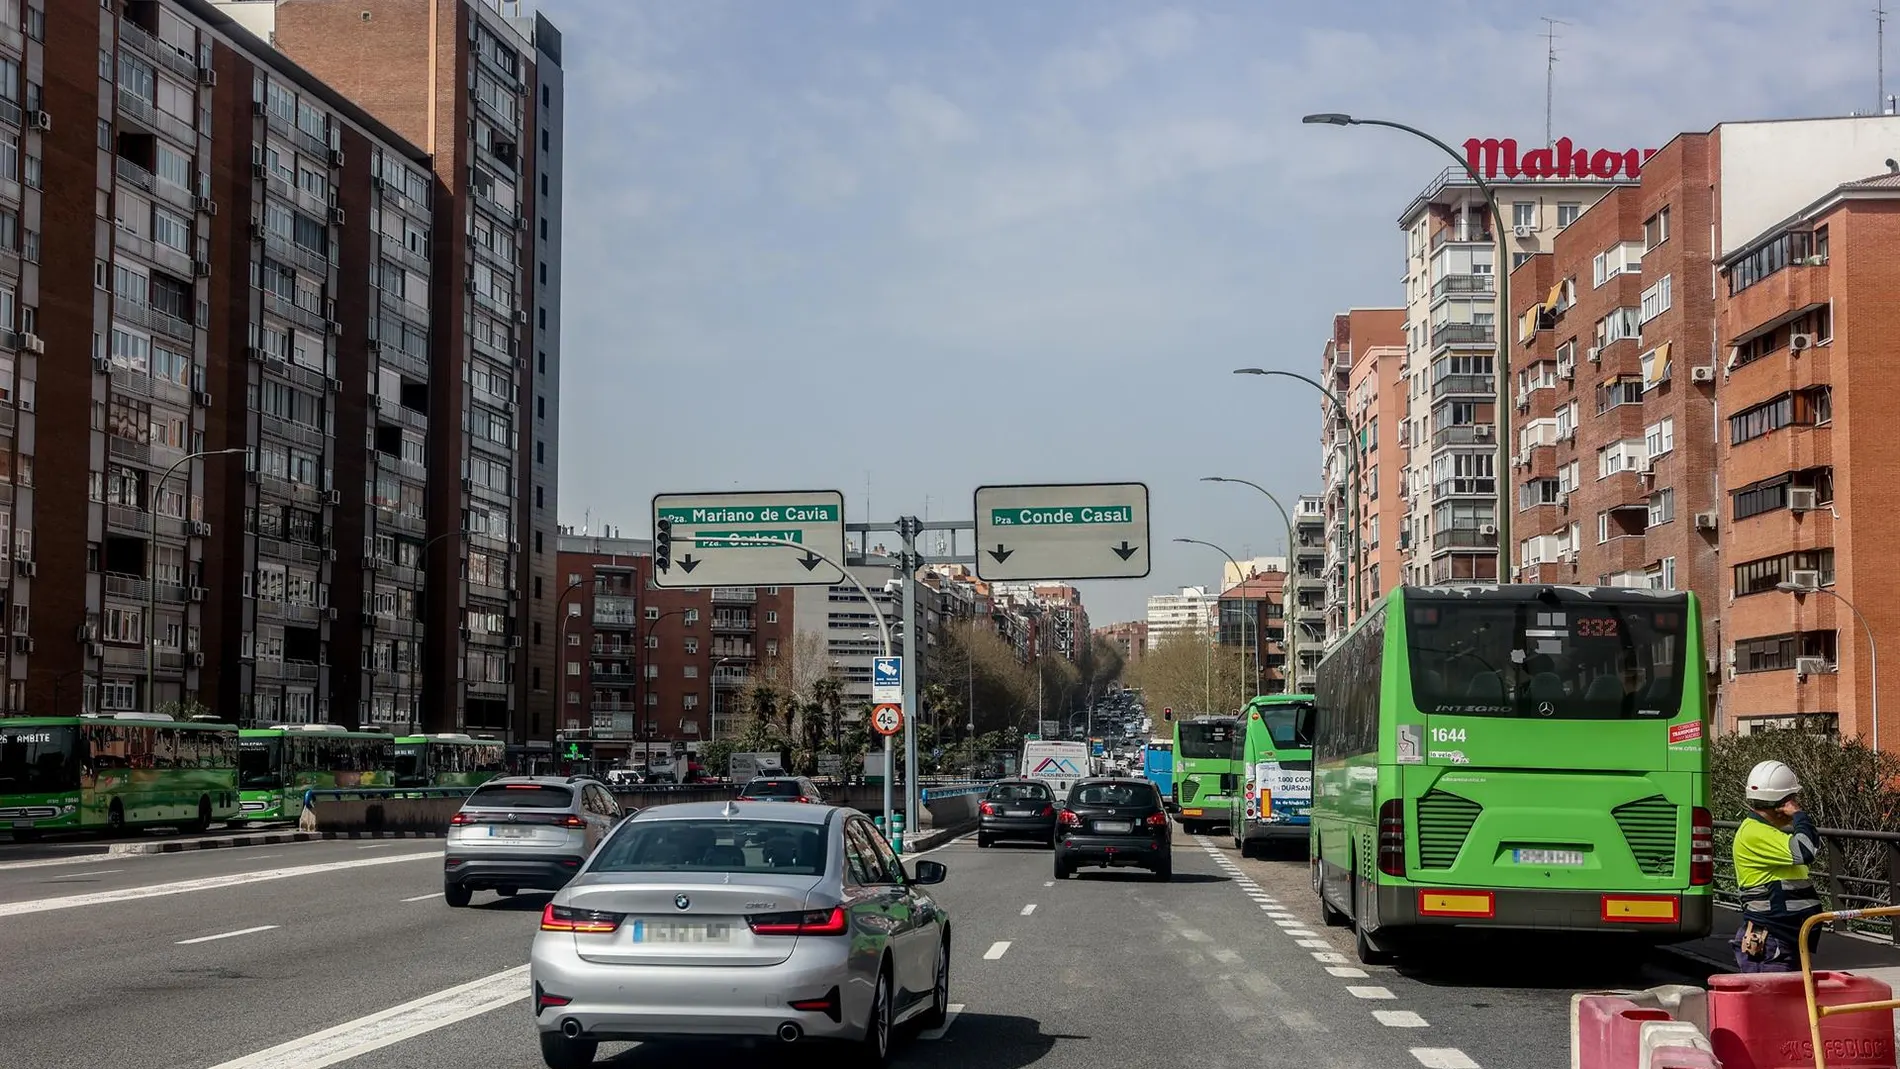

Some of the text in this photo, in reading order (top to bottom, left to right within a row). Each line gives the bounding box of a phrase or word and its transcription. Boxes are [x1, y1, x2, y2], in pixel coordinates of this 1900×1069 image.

[692, 508, 755, 522] Mariano
[760, 508, 779, 521] de
[785, 507, 829, 521] Cavia
[994, 507, 1129, 525] Pza. Conde Casal
[1577, 618, 1617, 637] 332
[1435, 705, 1513, 713] INTEGRO
[17, 733, 50, 743] AMBITE
[1431, 727, 1467, 743] 1644
